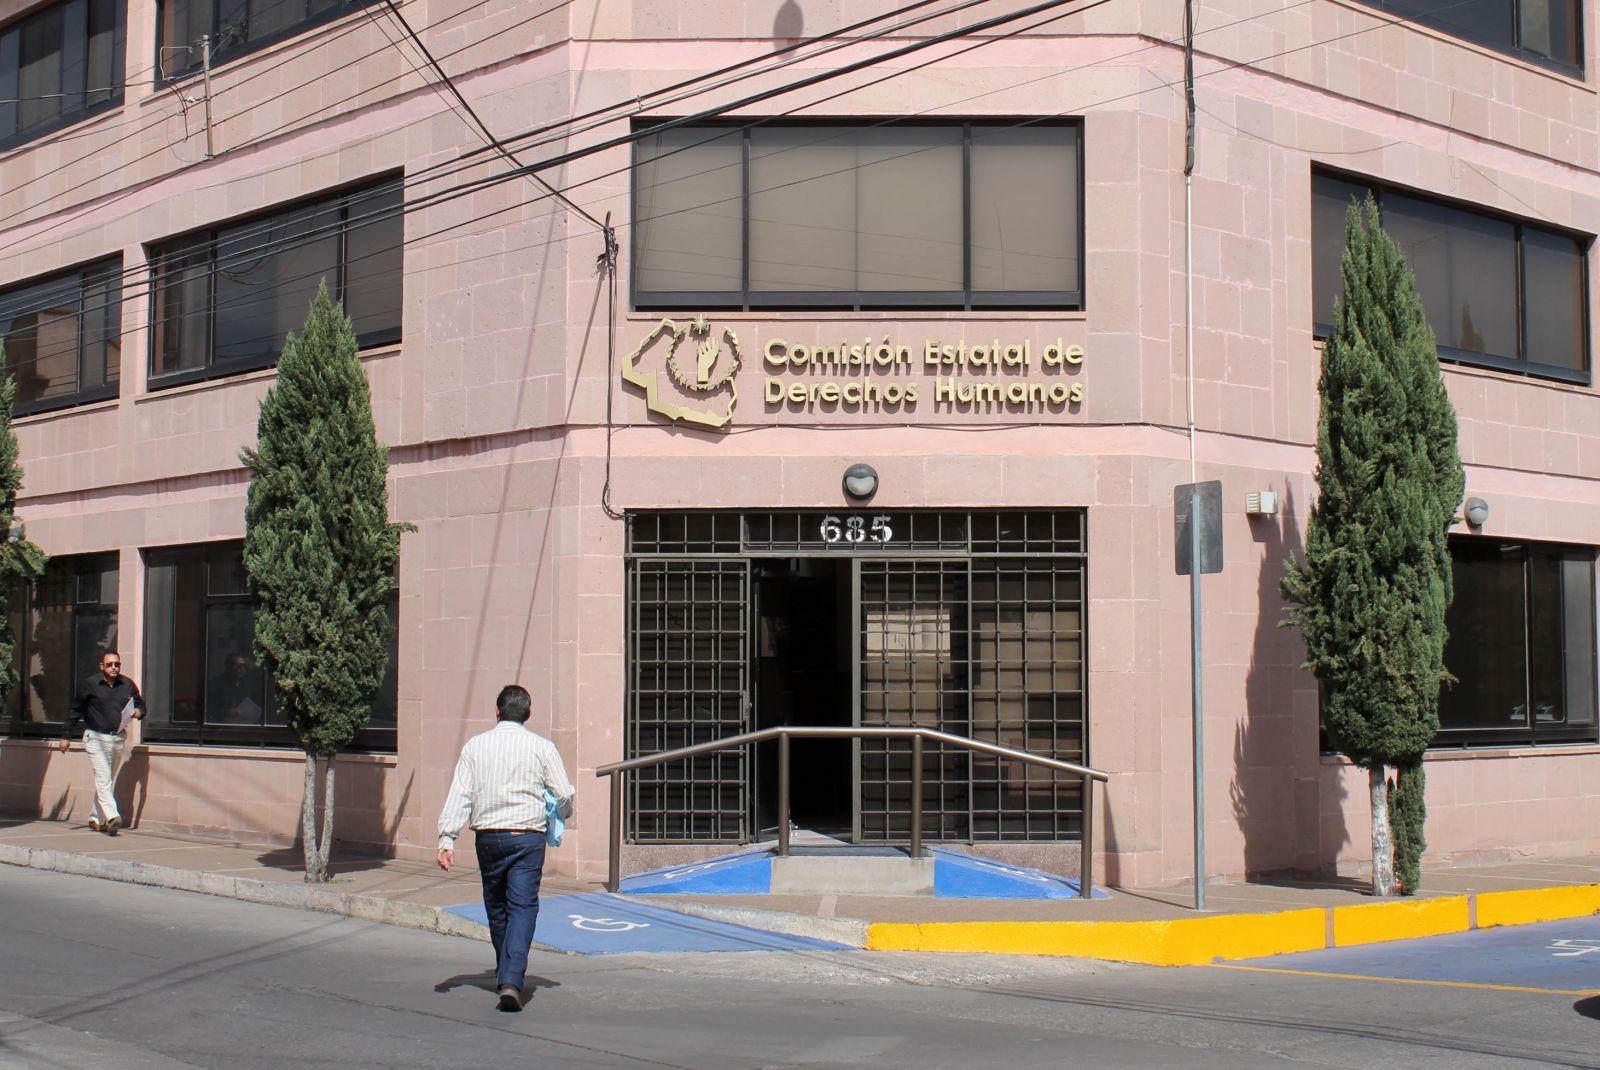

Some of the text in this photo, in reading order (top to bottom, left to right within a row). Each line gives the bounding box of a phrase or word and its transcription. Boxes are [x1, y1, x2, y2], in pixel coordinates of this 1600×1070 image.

[763, 335, 1085, 366] Comisión Estatal de
[764, 376, 1085, 404] Derechos Humanos
[820, 515, 893, 543] 685
